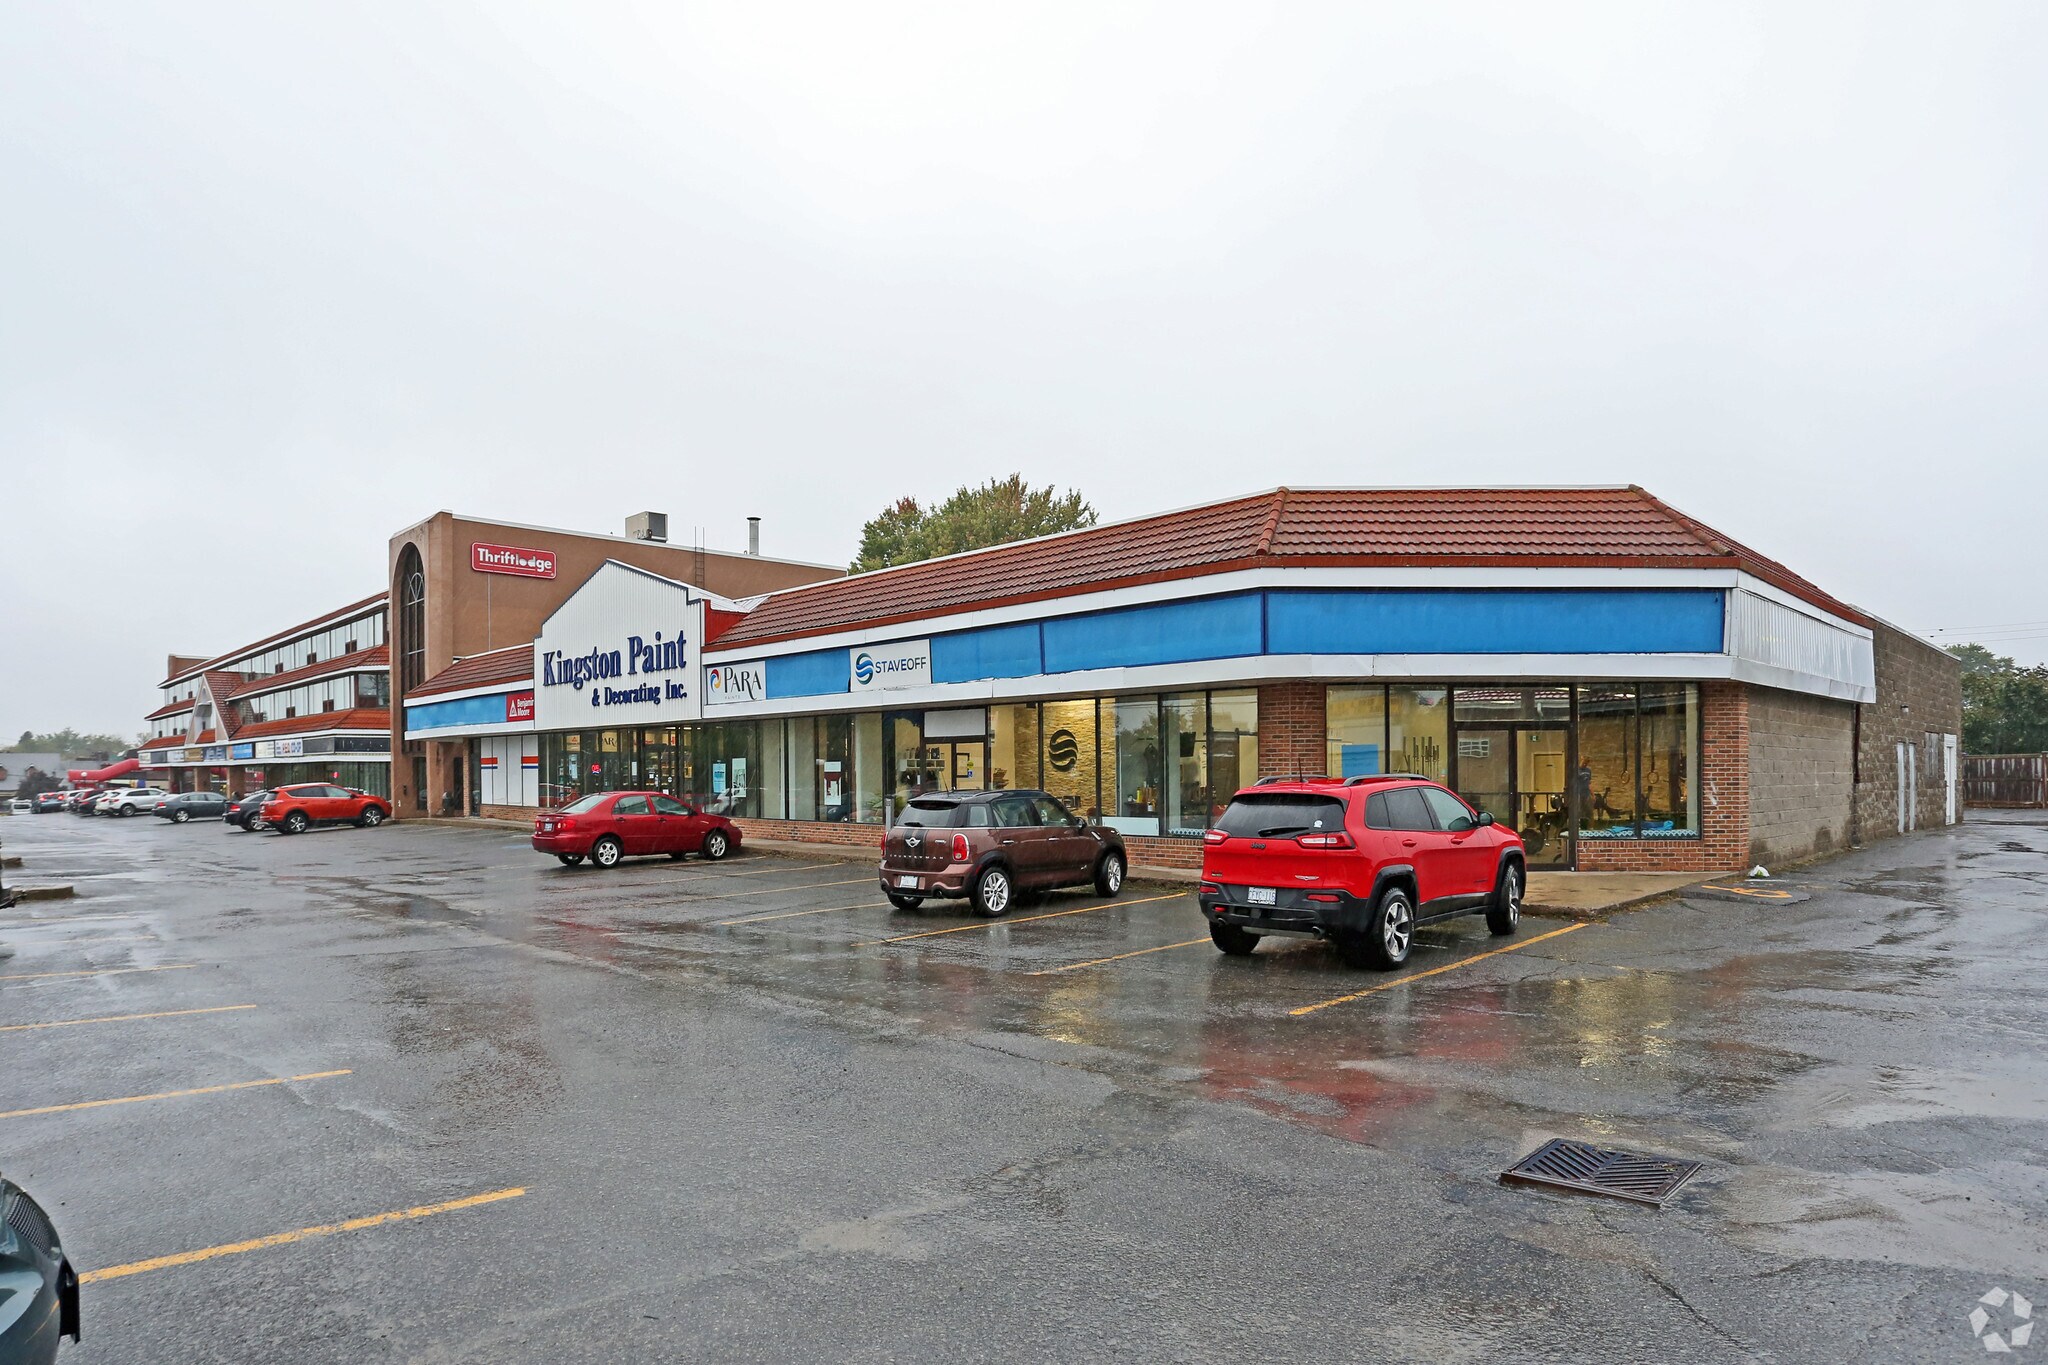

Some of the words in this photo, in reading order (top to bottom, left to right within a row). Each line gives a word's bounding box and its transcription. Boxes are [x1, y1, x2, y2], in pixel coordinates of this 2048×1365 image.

[477, 547, 552, 572] Thriftlodge
[543, 646, 622, 690] Kingston
[627, 630, 687, 675] Paint
[875, 656, 927, 674] STAVEOFF
[591, 688, 600, 706] &
[604, 683, 661, 705] Decorating
[665, 679, 688, 699] Inc.
[724, 667, 762, 700] PARA
